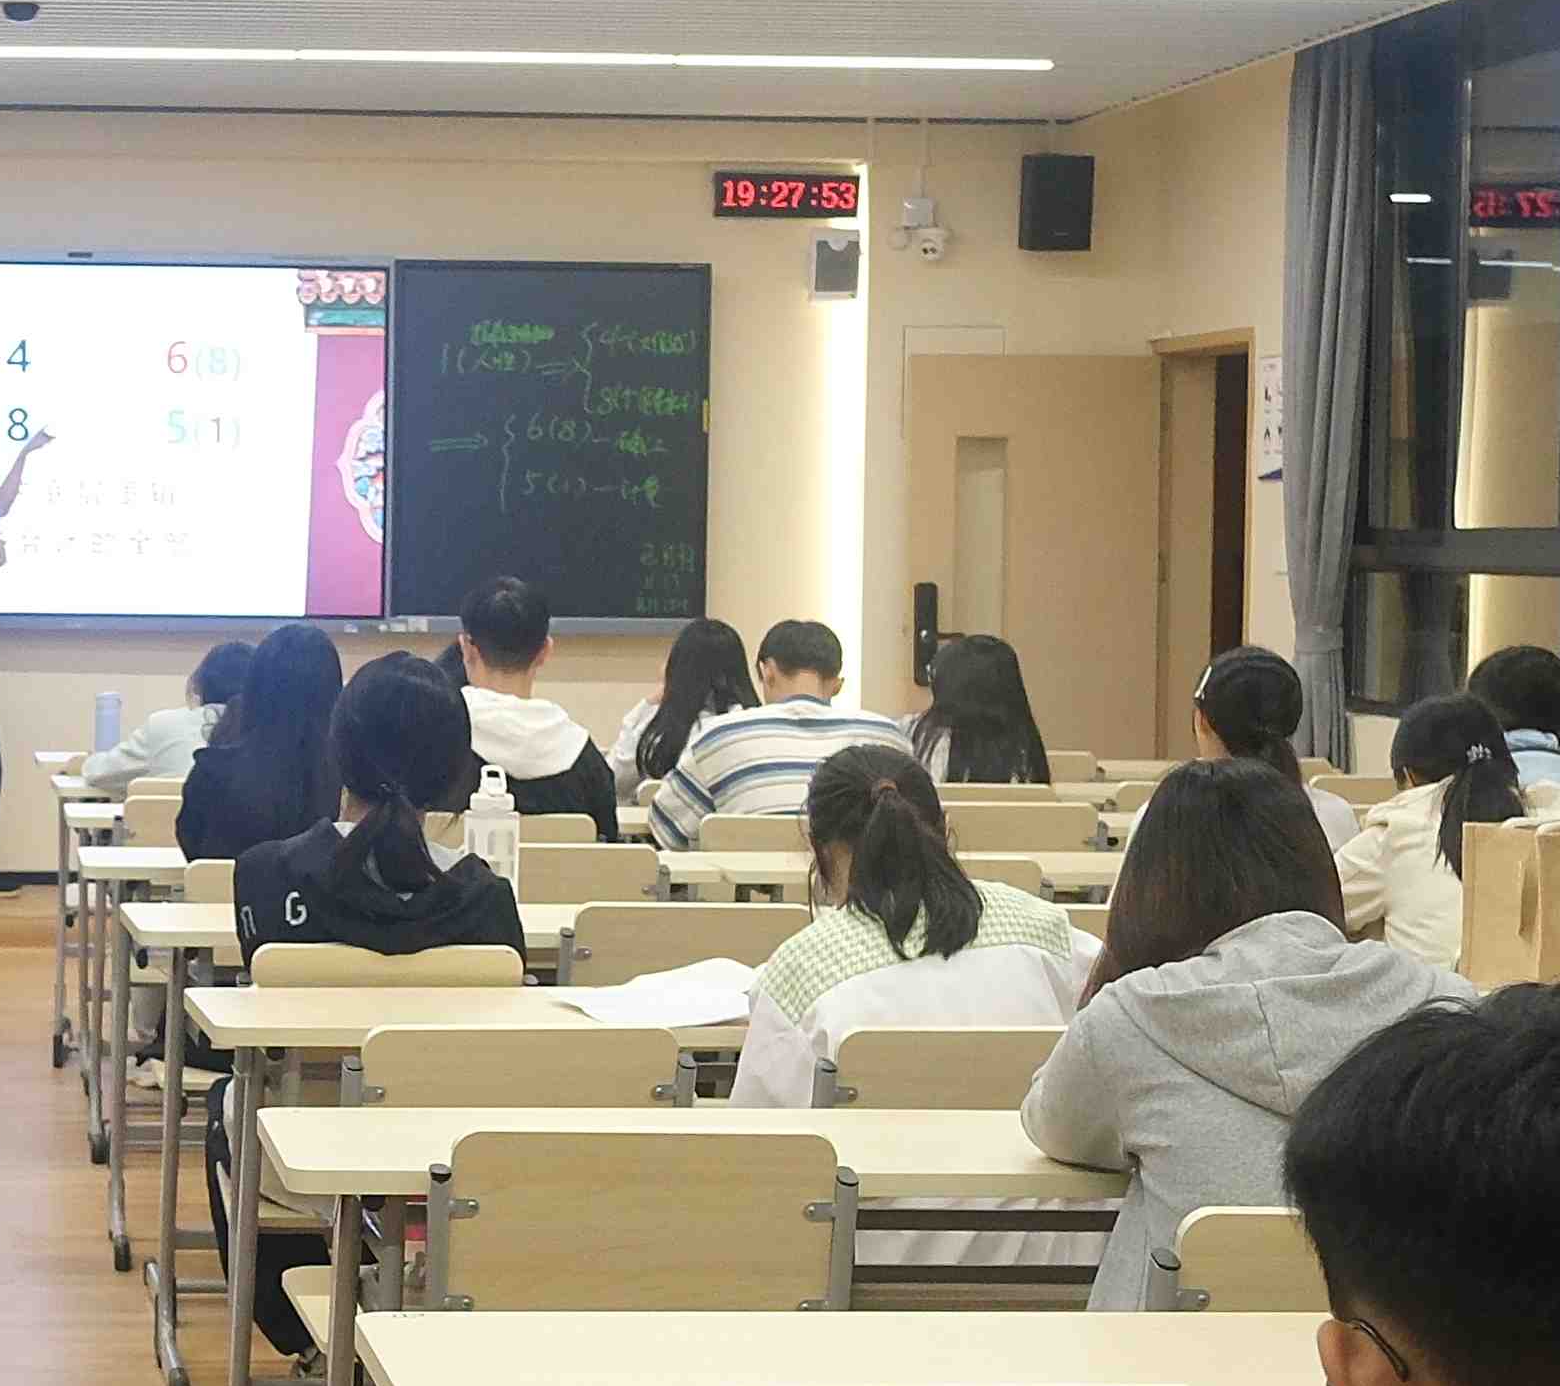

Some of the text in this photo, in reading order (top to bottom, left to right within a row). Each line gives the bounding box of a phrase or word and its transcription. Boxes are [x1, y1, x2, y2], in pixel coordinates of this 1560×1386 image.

[723, 179, 856, 209] 19:27:53
[6, 339, 31, 373] 4
[166, 340, 241, 381] 6(8)
[7, 407, 29, 442] 8
